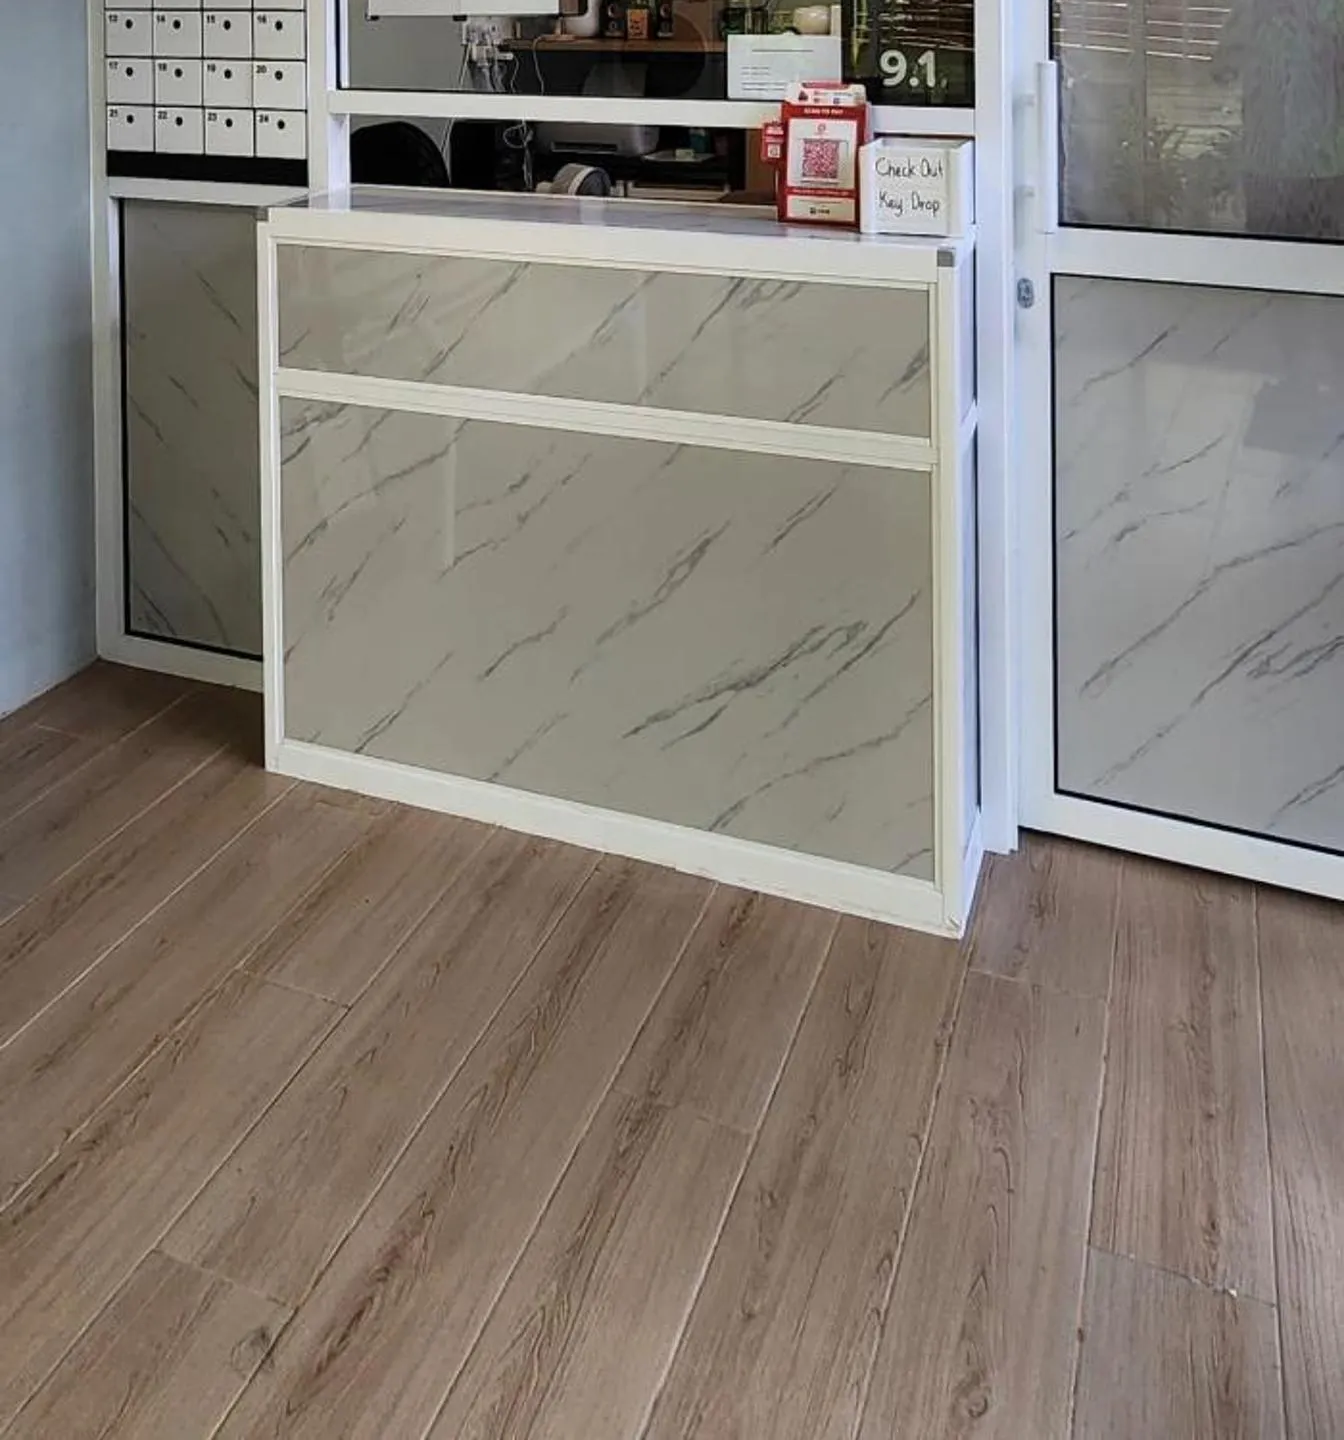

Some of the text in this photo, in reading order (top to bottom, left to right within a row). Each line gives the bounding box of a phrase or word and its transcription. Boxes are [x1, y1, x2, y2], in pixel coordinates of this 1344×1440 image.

[156, 14, 166, 24] 14
[206, 14, 216, 24] 15
[256, 14, 268, 24] 16
[108, 60, 119, 70] 17
[157, 62, 168, 72] 18
[206, 63, 217, 73] 19
[255, 64, 268, 75] 20
[880, 49, 936, 88] 9.1
[109, 108, 119, 118] 21
[157, 110, 168, 120] 22
[207, 112, 218, 122] 23
[258, 114, 270, 124] 24
[875, 156, 944, 178] Check Out
[878, 190, 940, 218] Key Drop
